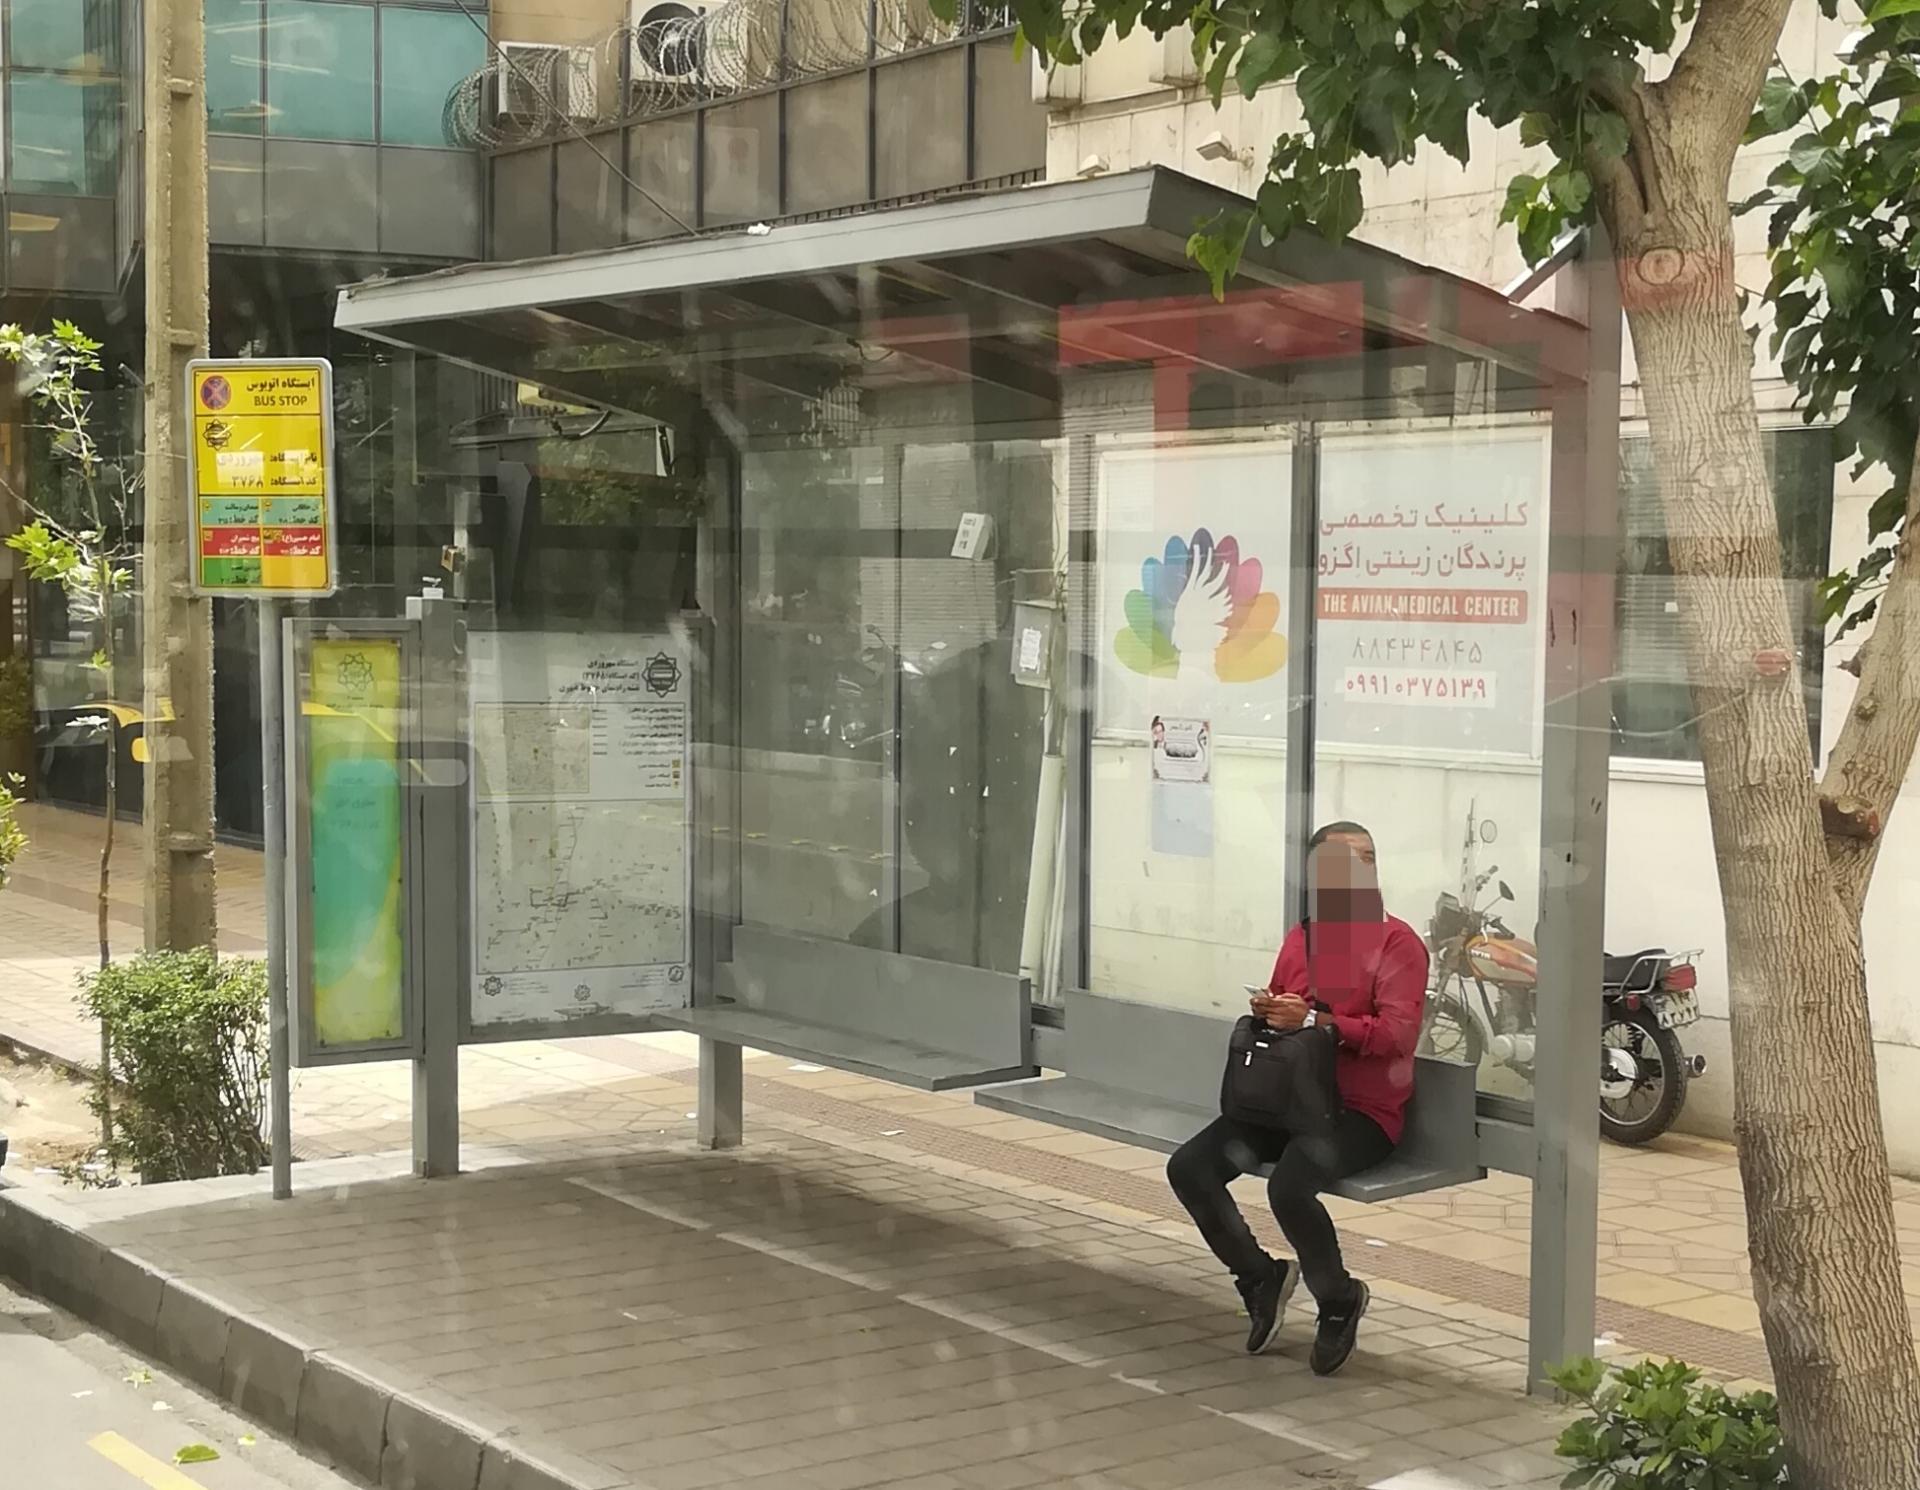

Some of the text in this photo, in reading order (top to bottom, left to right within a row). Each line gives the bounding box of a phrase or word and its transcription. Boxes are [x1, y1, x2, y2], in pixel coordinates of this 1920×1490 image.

[246, 377, 315, 392] ایستگاه اتوبوس
[254, 395, 308, 406] BUS STOP
[1320, 502, 1528, 536] کلینیک تخصصی
[1366, 546, 1431, 577] زینتی
[1437, 541, 1527, 581] پرندگان
[1323, 594, 1520, 617] THE AVIAN MEDICAL CENTER
[1352, 636, 1483, 664] ۸۸۴۳۴۸۴۵
[1346, 673, 1487, 699] ۰۹۹۱۰۳۷۵۱۳۹
